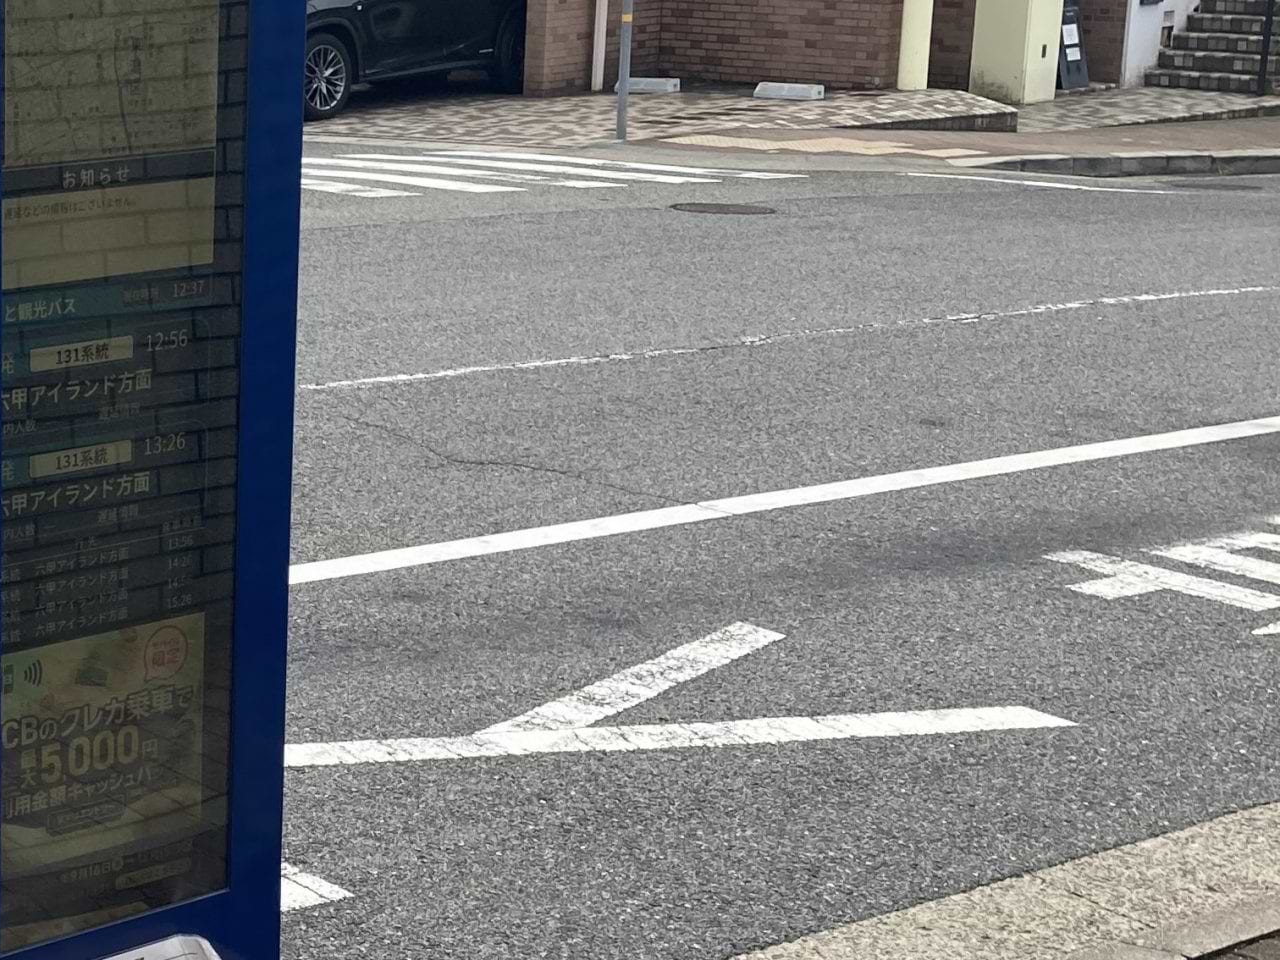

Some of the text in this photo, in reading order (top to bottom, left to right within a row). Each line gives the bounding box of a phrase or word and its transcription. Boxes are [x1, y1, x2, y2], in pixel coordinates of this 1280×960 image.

[62, 166, 131, 189] お知らせ
[146, 329, 188, 352] 12:56
[55, 344, 109, 365] 131系統
[144, 432, 186, 455] 13:26
[55, 447, 108, 470] 131系統
